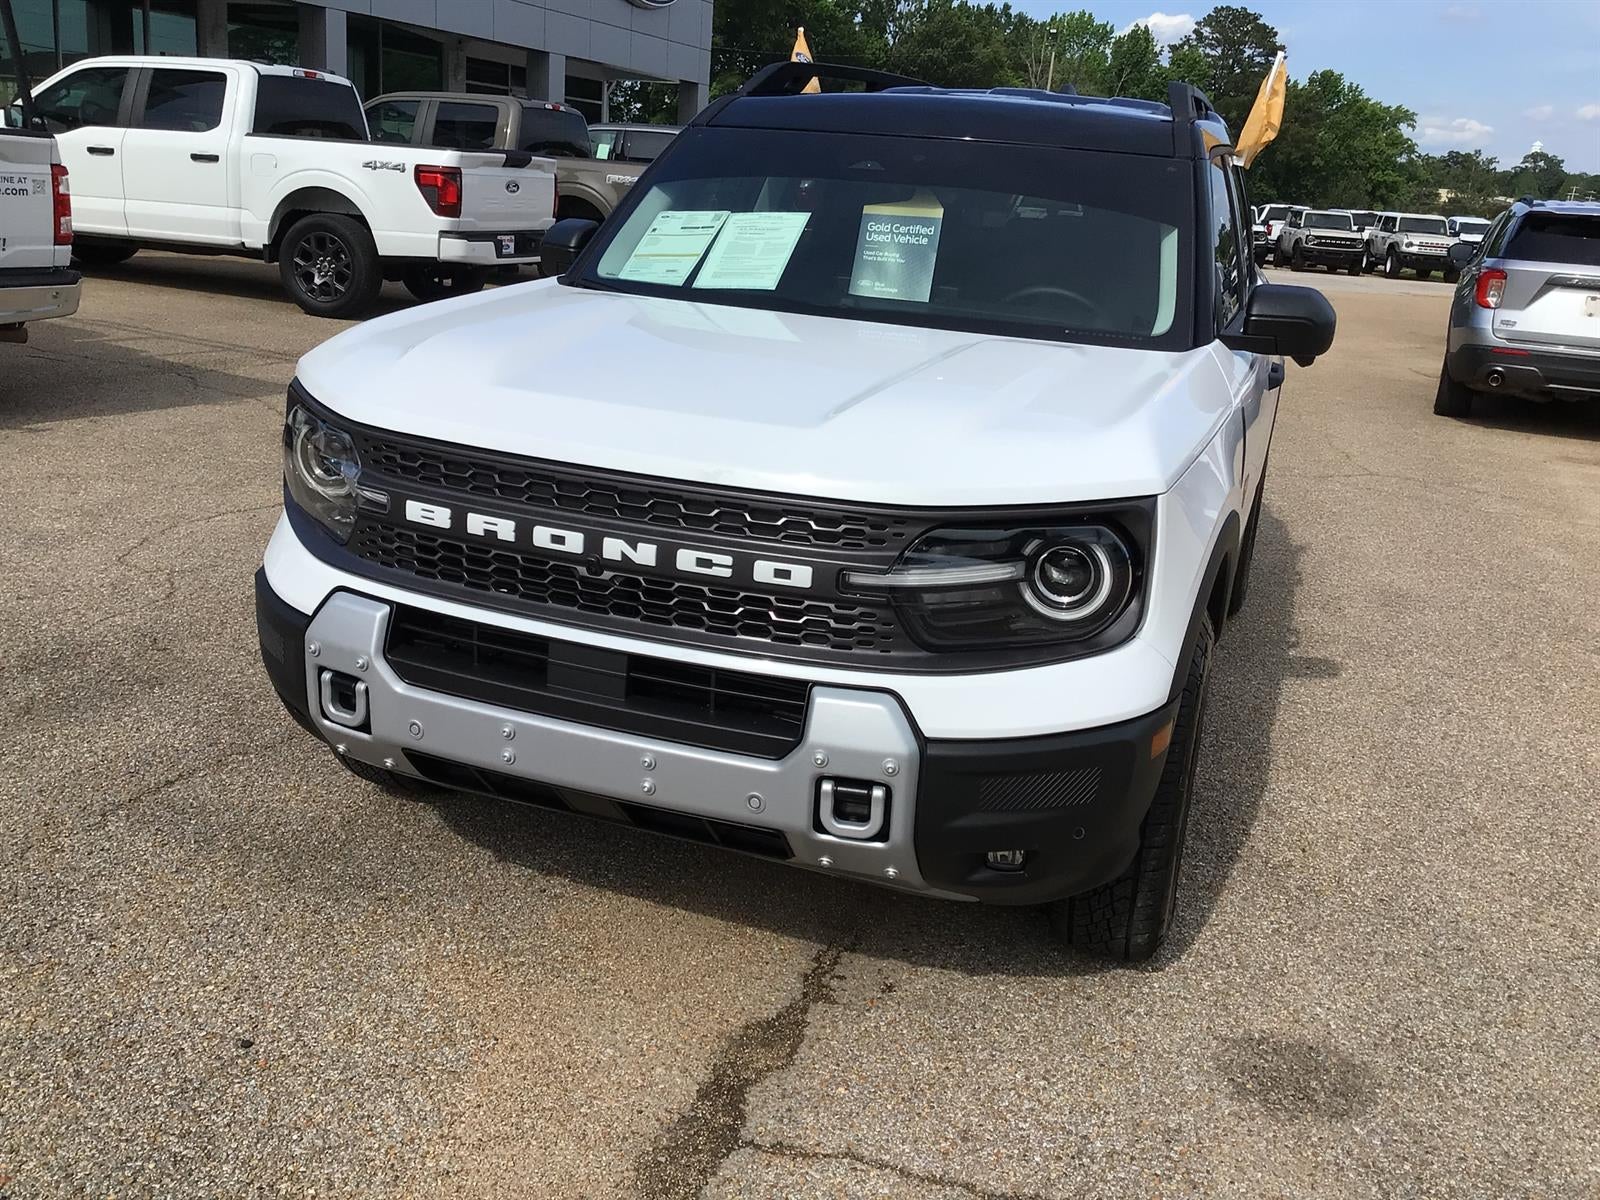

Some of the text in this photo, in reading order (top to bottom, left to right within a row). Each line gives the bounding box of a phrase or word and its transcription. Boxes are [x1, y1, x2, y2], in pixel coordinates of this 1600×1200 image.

[17, 176, 28, 184] AT
[0, 187, 28, 196] .com
[867, 222, 934, 235] Gold Certified
[866, 231, 928, 244] Used Vehicle
[405, 499, 813, 589] BRONCO
